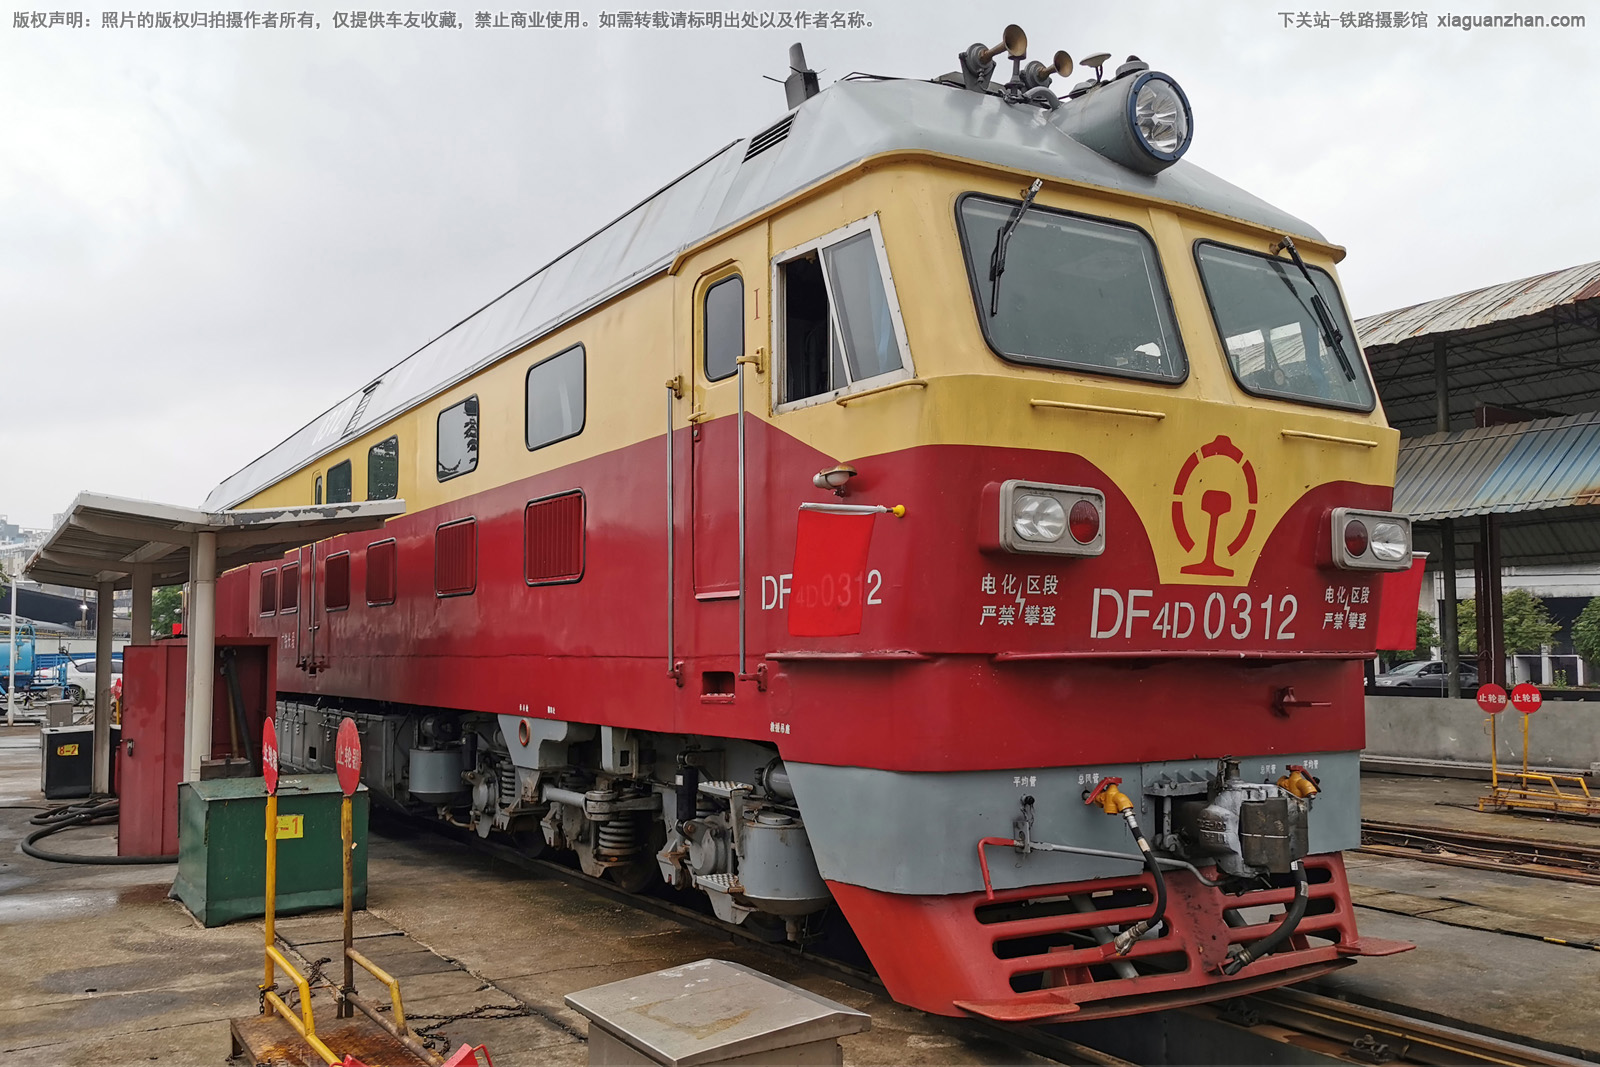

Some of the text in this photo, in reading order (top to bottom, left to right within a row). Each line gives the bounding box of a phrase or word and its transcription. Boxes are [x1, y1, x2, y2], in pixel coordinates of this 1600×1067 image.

[979, 605, 1057, 626] 严禁攀登
[1478, 693, 1506, 704] 止轮器
[1513, 693, 1540, 703] 止轮器
[58, 745, 77, 755] 8-2
